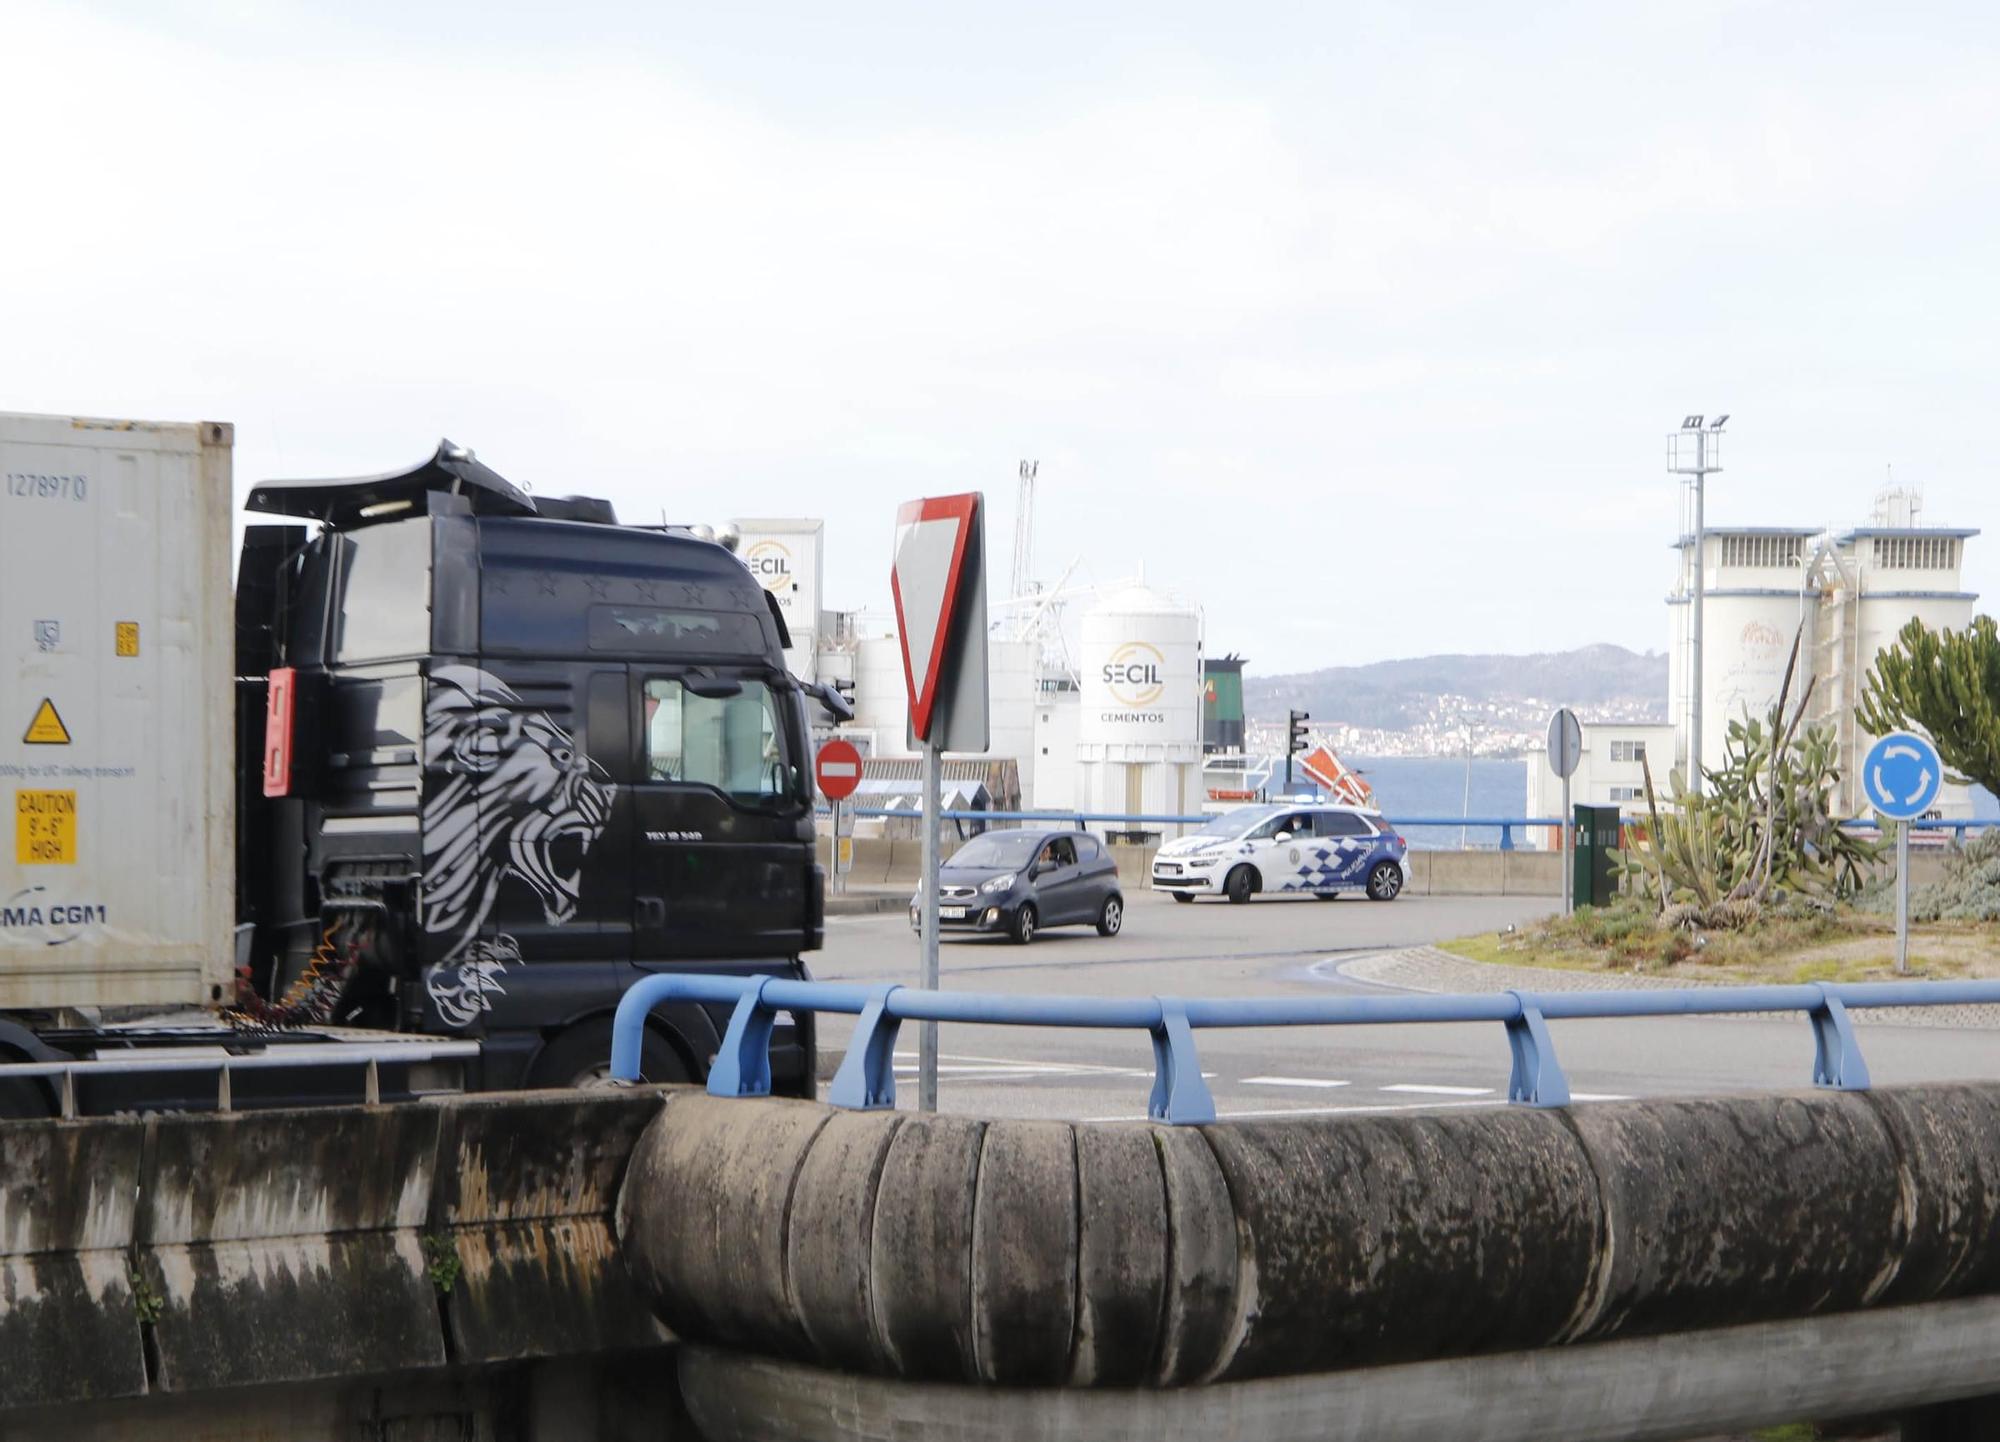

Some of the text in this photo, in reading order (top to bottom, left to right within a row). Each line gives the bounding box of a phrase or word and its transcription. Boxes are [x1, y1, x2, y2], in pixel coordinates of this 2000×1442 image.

[751, 558, 791, 575] ECIL
[1103, 664, 1163, 684] SECIL
[1101, 713, 1164, 723] CEMENTOS
[18, 794, 74, 814] CAUTION
[0, 905, 106, 927] MA CGM
